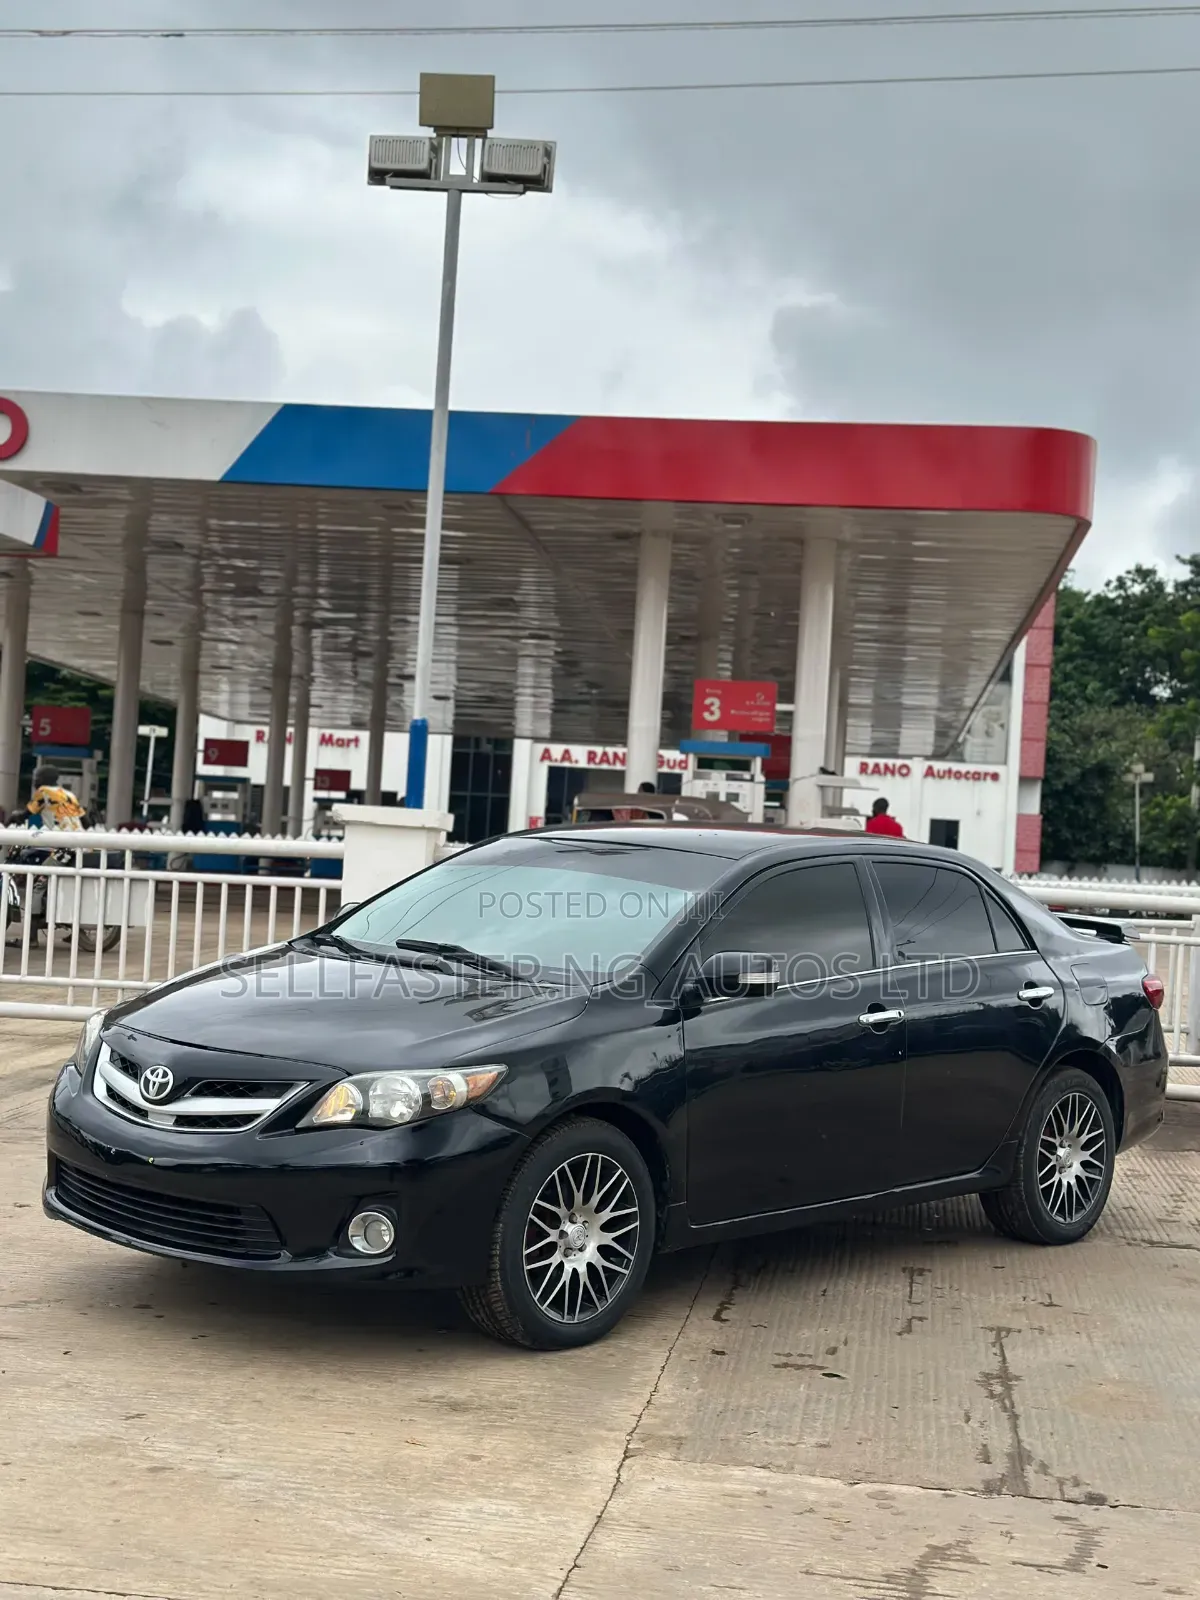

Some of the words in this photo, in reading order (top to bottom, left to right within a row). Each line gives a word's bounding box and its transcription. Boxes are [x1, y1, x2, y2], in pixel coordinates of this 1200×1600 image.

[702, 696, 721, 722] 3
[38, 719, 51, 736] 5
[320, 734, 360, 748] Mart
[207, 748, 219, 761] 9
[540, 748, 579, 764] A.A.
[587, 750, 627, 767] RAN
[859, 762, 911, 777] RANO
[923, 765, 1000, 782] Autocare
